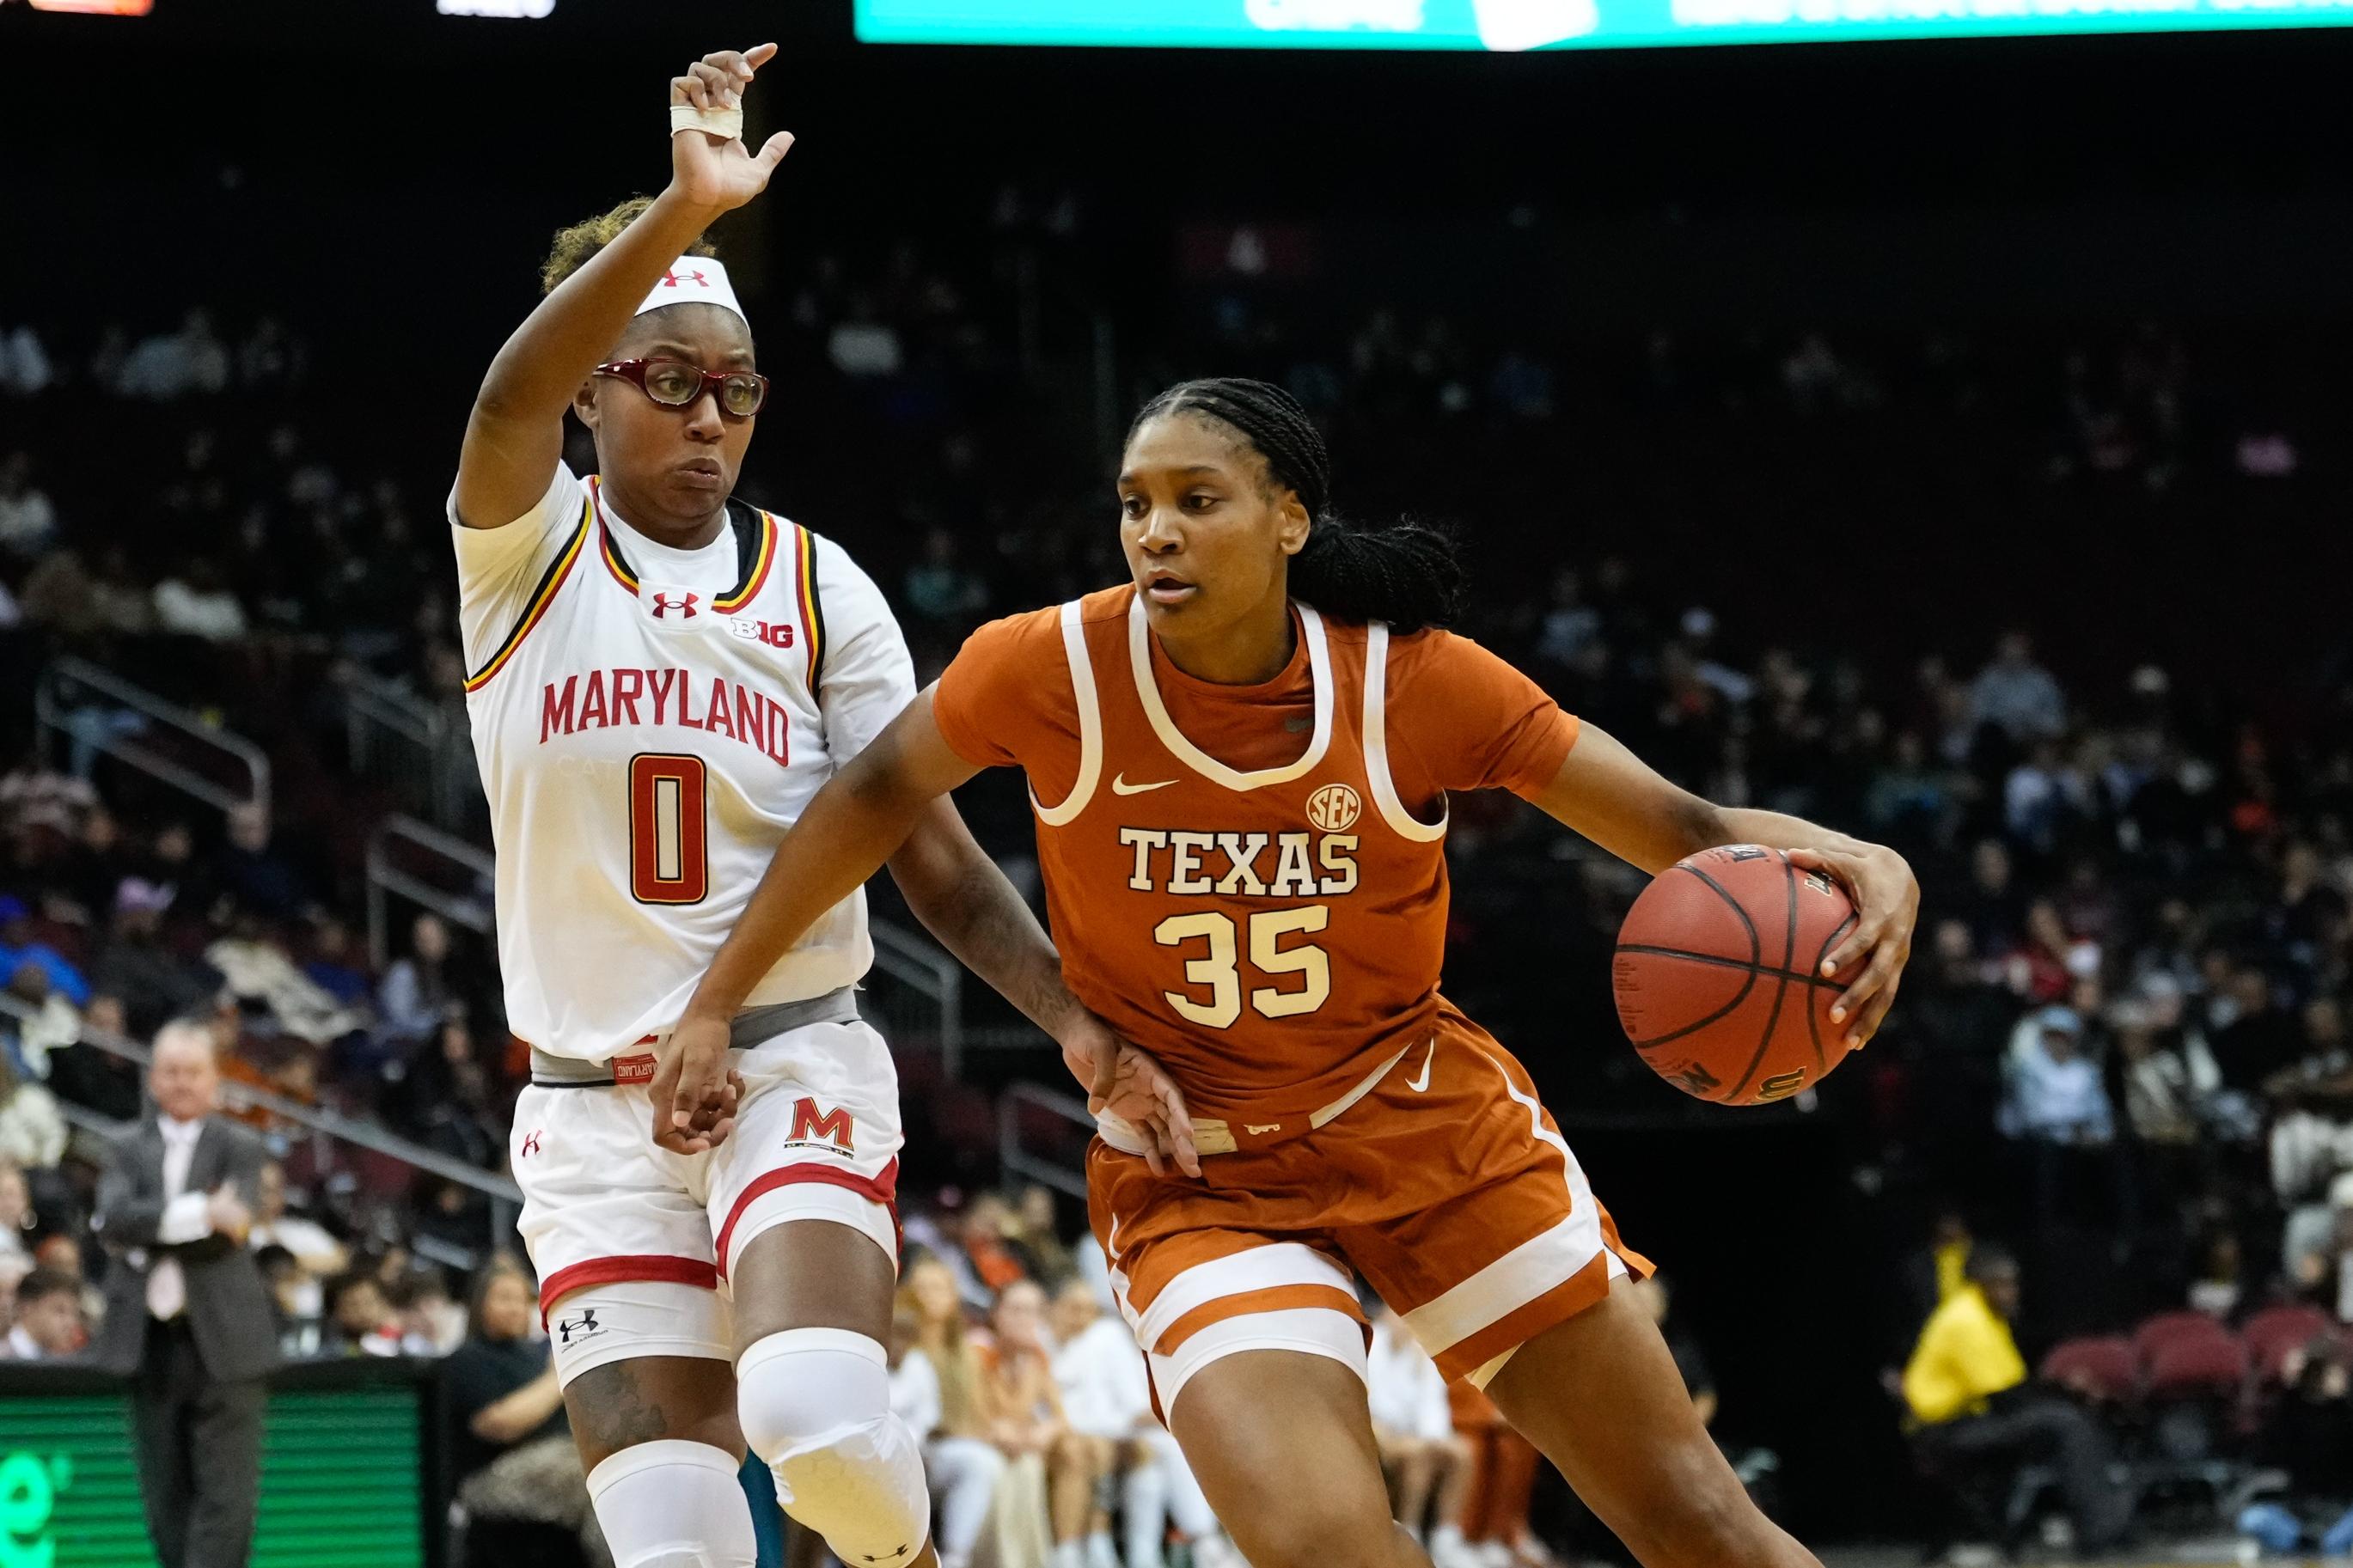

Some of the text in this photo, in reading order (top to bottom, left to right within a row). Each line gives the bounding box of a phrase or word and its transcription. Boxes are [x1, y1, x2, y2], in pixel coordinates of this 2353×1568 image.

[539, 668, 789, 767] MARYLAND
[628, 752, 709, 905] 0
[1311, 787, 1358, 830] SEC
[1119, 827, 1359, 896] TEXAS
[1153, 905, 1331, 1030] 35
[785, 1096, 854, 1152] M
